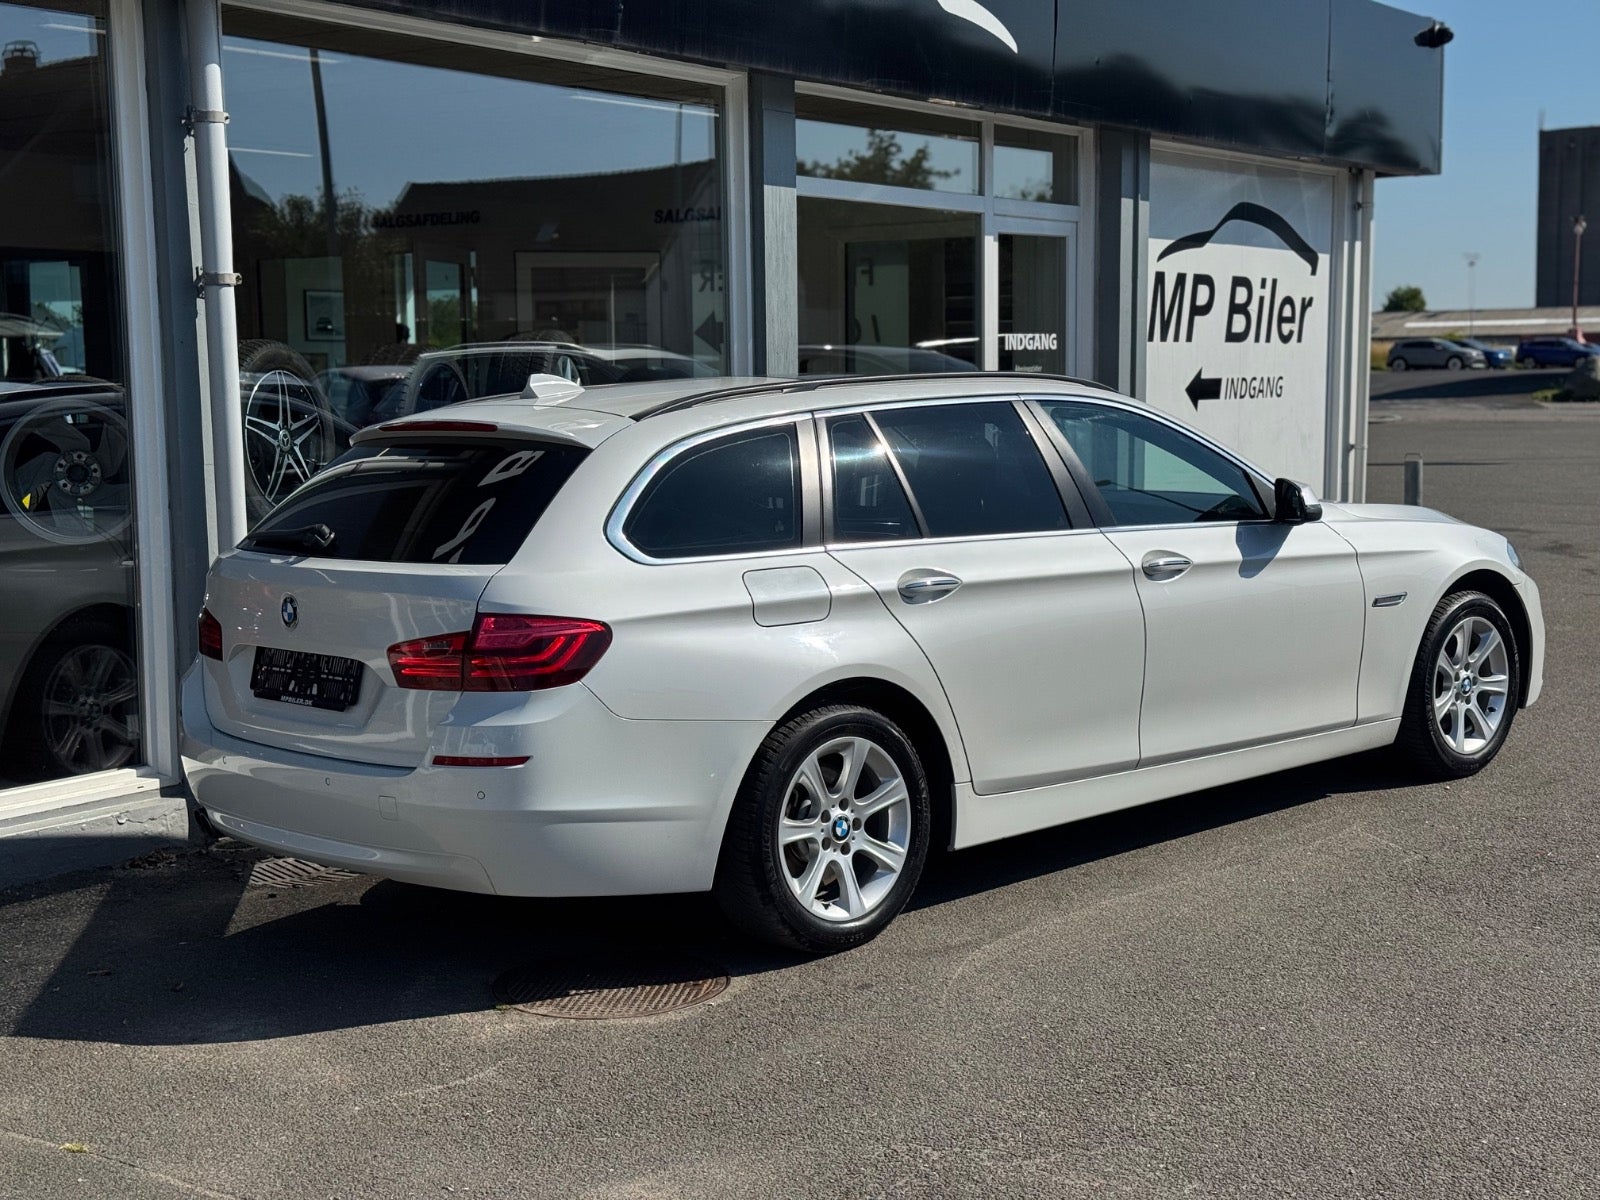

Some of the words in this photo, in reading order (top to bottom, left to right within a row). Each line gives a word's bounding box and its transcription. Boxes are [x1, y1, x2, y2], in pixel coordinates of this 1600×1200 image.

[1147, 270, 1215, 343] MP
[1225, 275, 1314, 344] Biler
[1004, 333, 1058, 351] INDGANG
[1224, 376, 1284, 400] INDGANG
